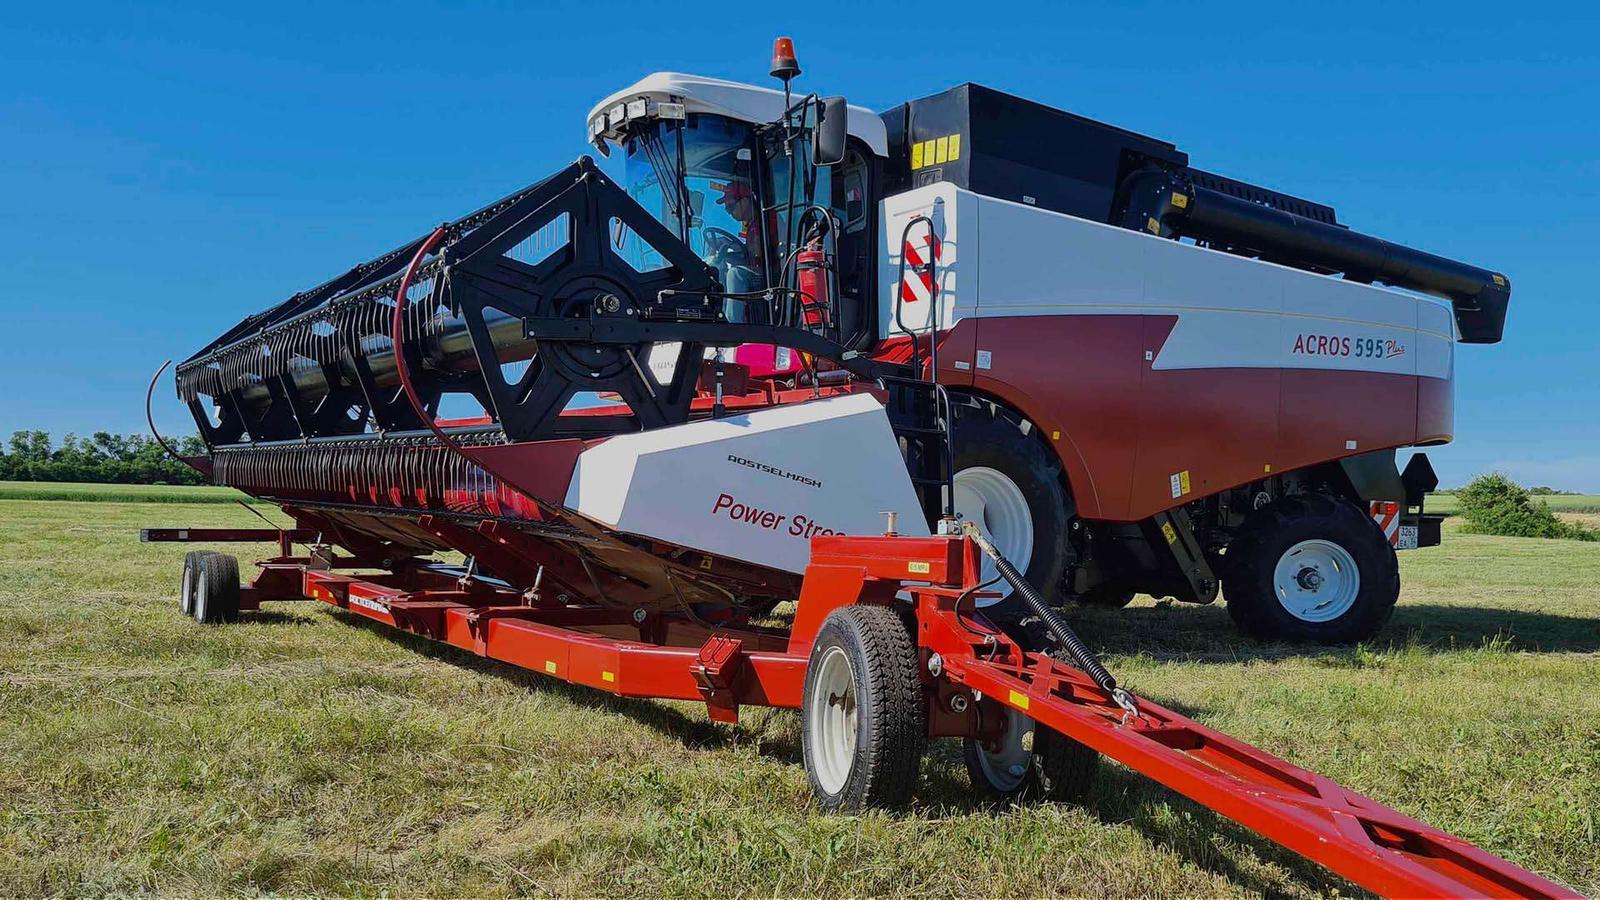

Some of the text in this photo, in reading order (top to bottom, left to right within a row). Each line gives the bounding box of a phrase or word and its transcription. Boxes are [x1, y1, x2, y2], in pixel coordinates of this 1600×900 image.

[1293, 333, 1405, 359] ACROS 595 Plus
[727, 454, 822, 489] ROSTSELMASH
[712, 493, 847, 540] Power Stre
